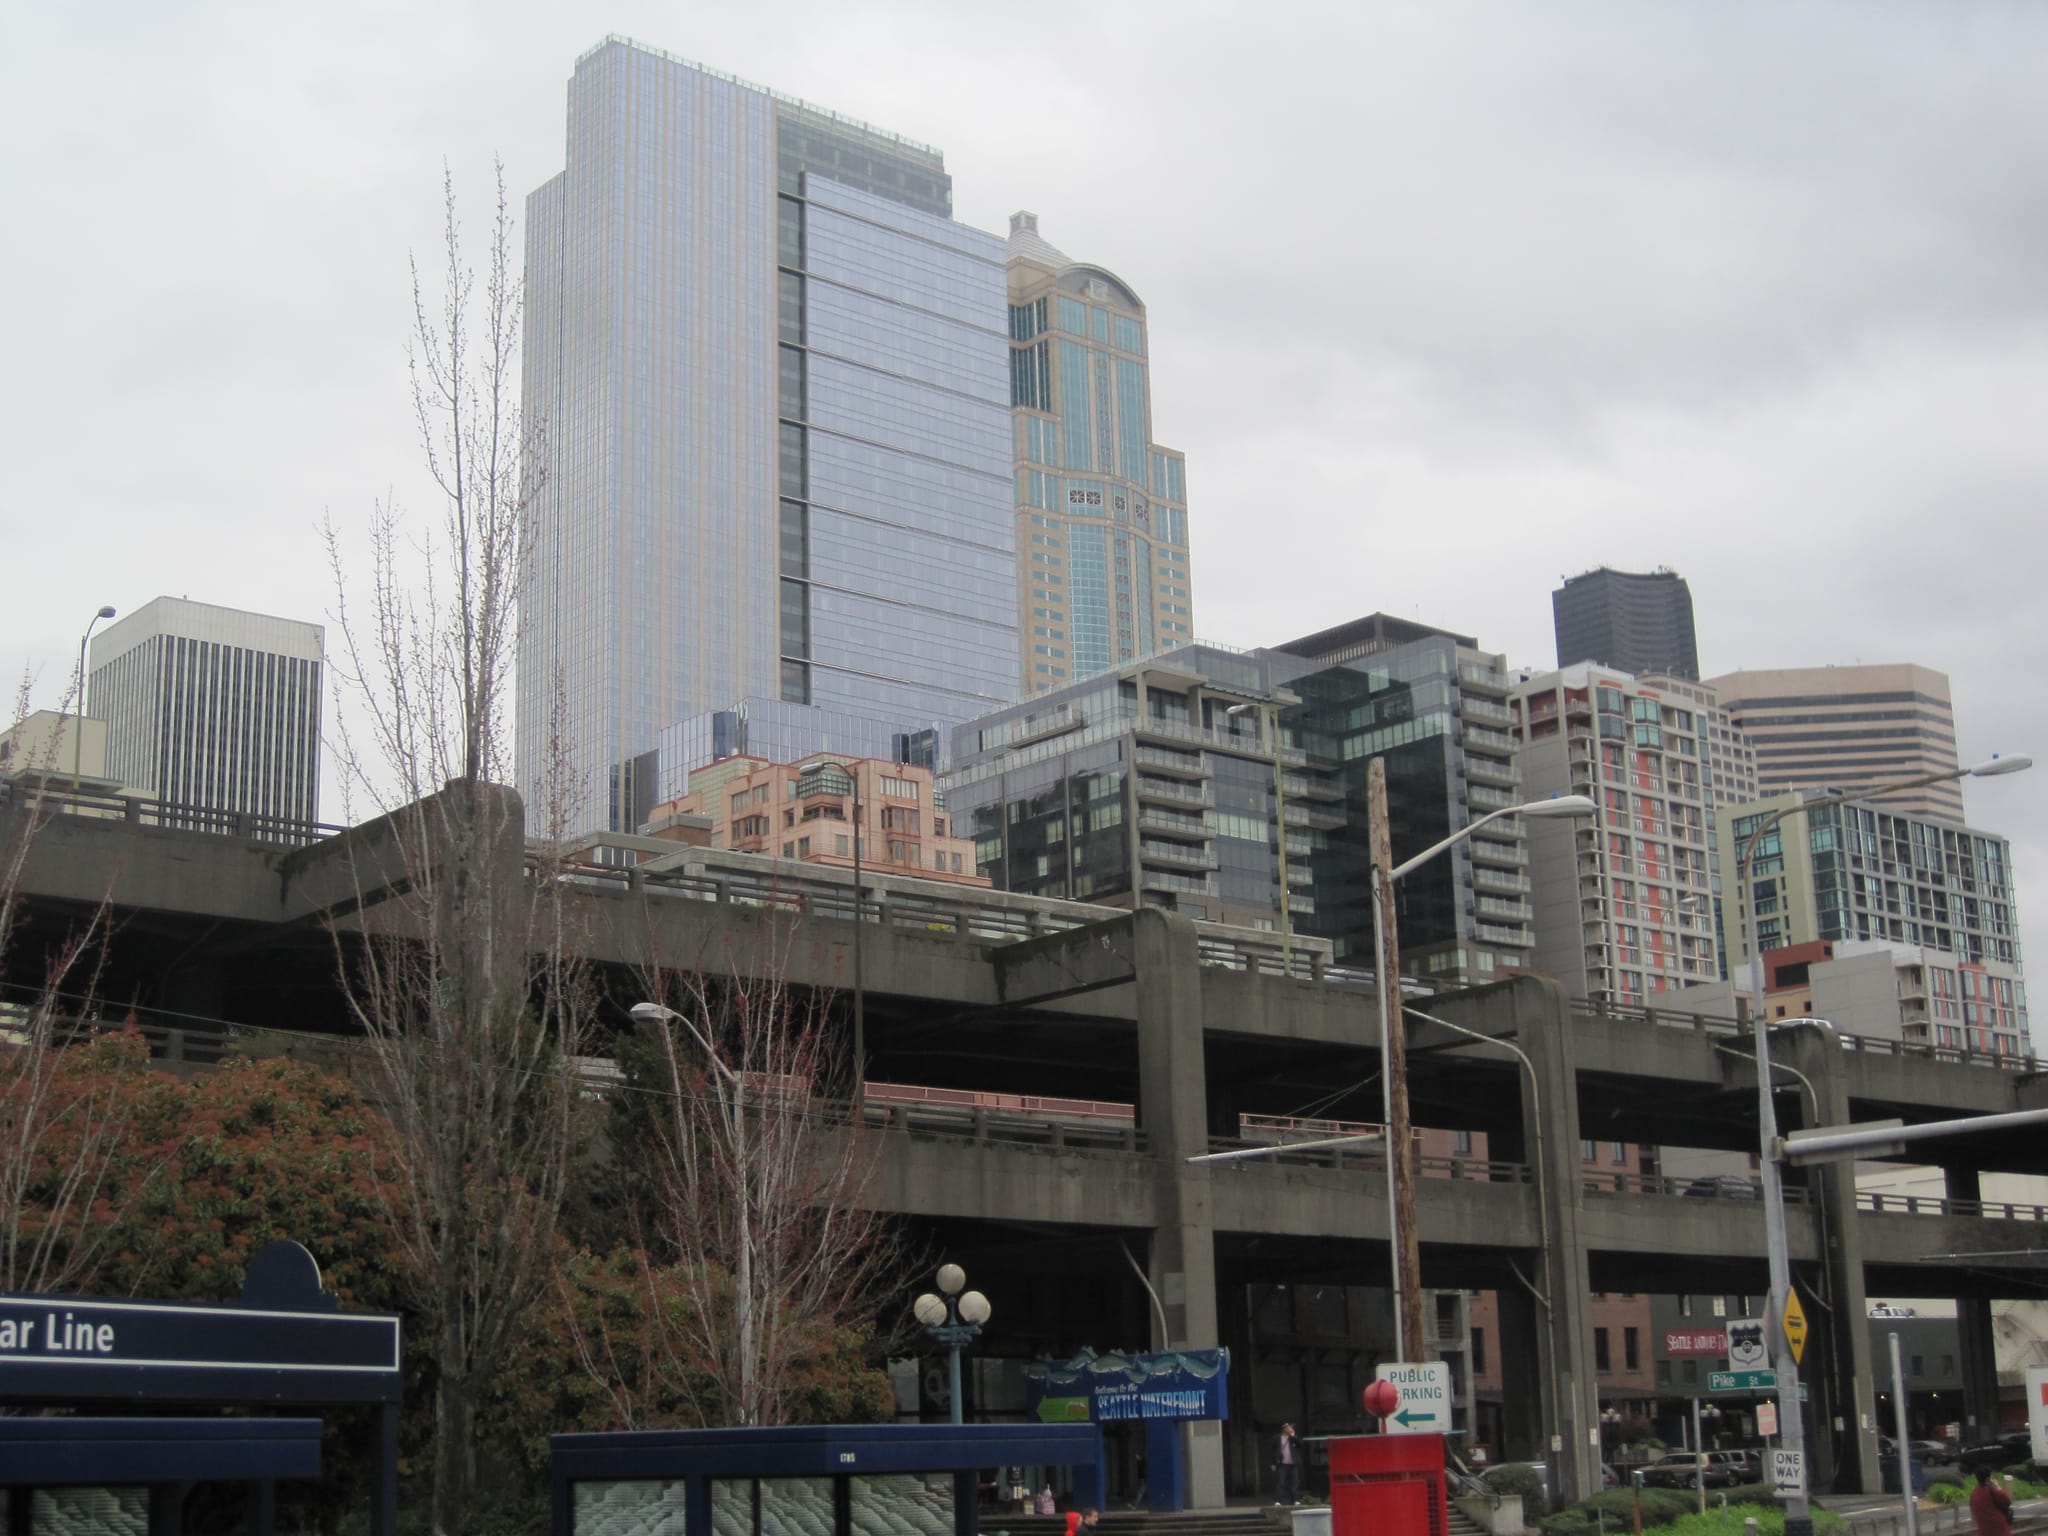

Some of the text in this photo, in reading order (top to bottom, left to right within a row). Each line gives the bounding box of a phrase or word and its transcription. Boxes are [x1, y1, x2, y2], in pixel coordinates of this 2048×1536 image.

[46, 1312, 114, 1351] Line
[1389, 1370, 1436, 1383] PUBLIC
[1712, 1374, 1758, 1388] Pike St
[1402, 1387, 1442, 1400] RKING
[1097, 1390, 1206, 1420] SEATTLE WATERFRONT
[1776, 1453, 1800, 1464] ONE
[1776, 1466, 1800, 1478] WAY
